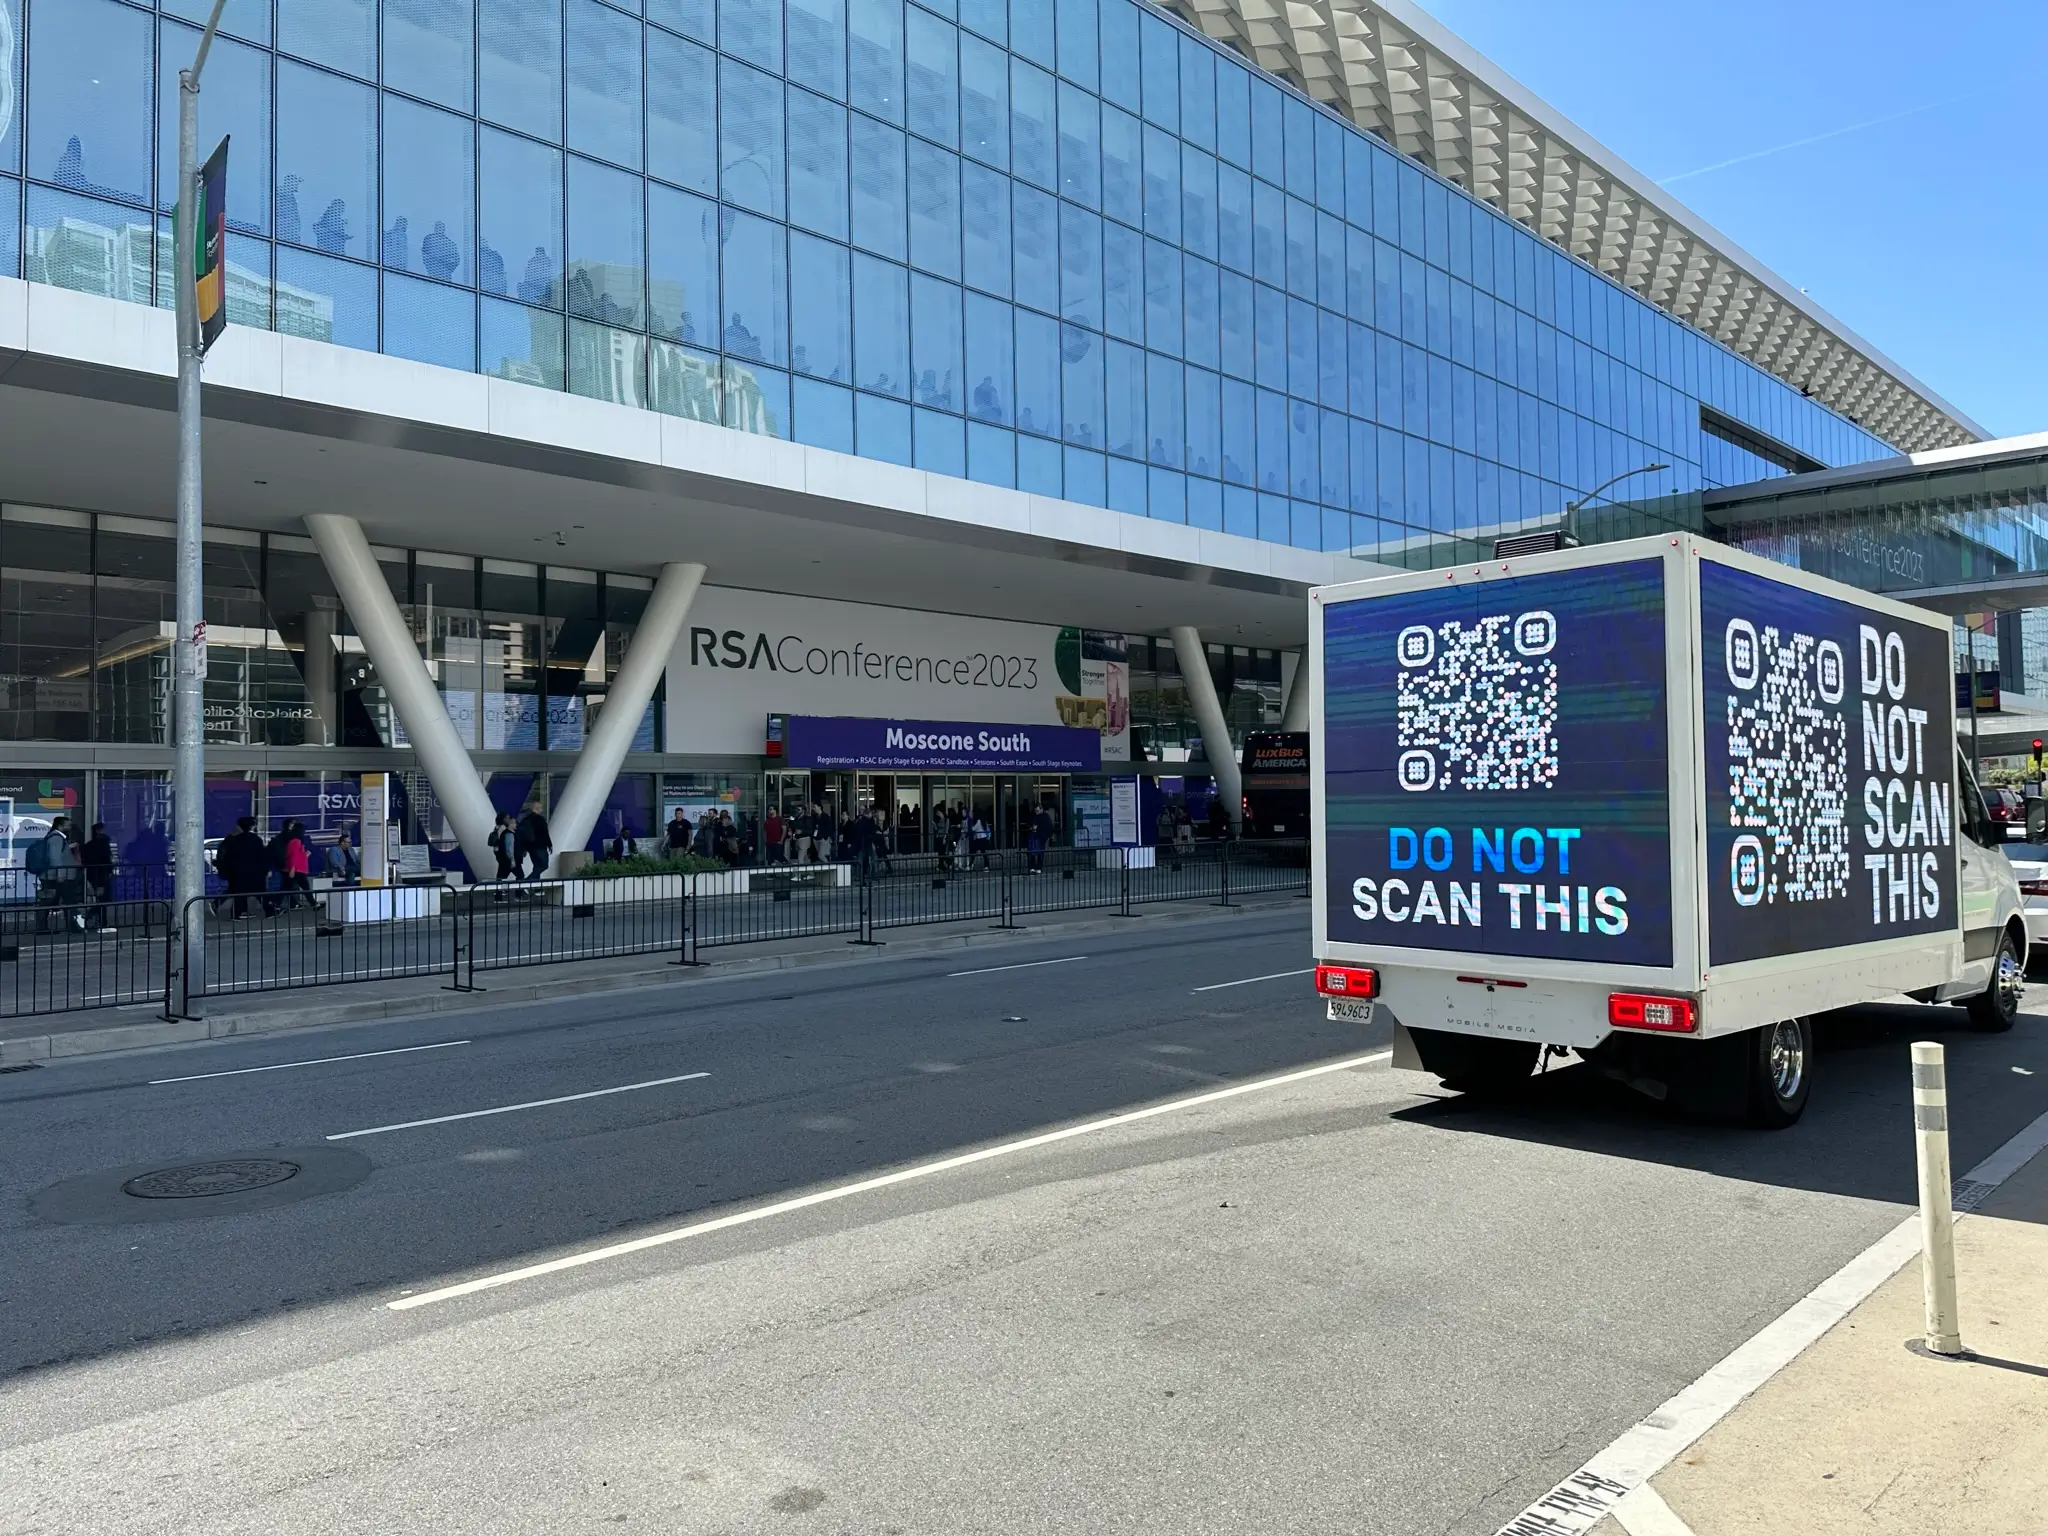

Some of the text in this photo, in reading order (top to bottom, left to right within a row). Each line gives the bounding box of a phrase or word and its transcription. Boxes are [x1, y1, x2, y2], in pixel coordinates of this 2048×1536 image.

[1082, 669, 1105, 679] Stronger
[1860, 624, 1906, 700] DO
[886, 728, 1031, 752] Moscone South
[1104, 746, 1122, 754] #RSAC
[1862, 701, 1927, 775] NOT
[817, 755, 854, 765] Registration
[878, 757, 892, 765] Early
[894, 758, 910, 766] Stage
[911, 758, 925, 766] Expo
[946, 758, 969, 766] Sandbox
[1016, 759, 1028, 767] Expo
[1047, 760, 1060, 768] Stage
[1061, 760, 1082, 768] Keynotes
[1252, 759, 1308, 768] AMERICA
[1864, 776, 1950, 848] SCAN
[1389, 827, 1581, 874] DO NOT
[1864, 852, 1940, 924] THIS
[1352, 877, 1629, 935] SCAN THIS
[1330, 1002, 1370, 1019] 59496C3
[1447, 1018, 1536, 1033] MOBILE MEDIA
